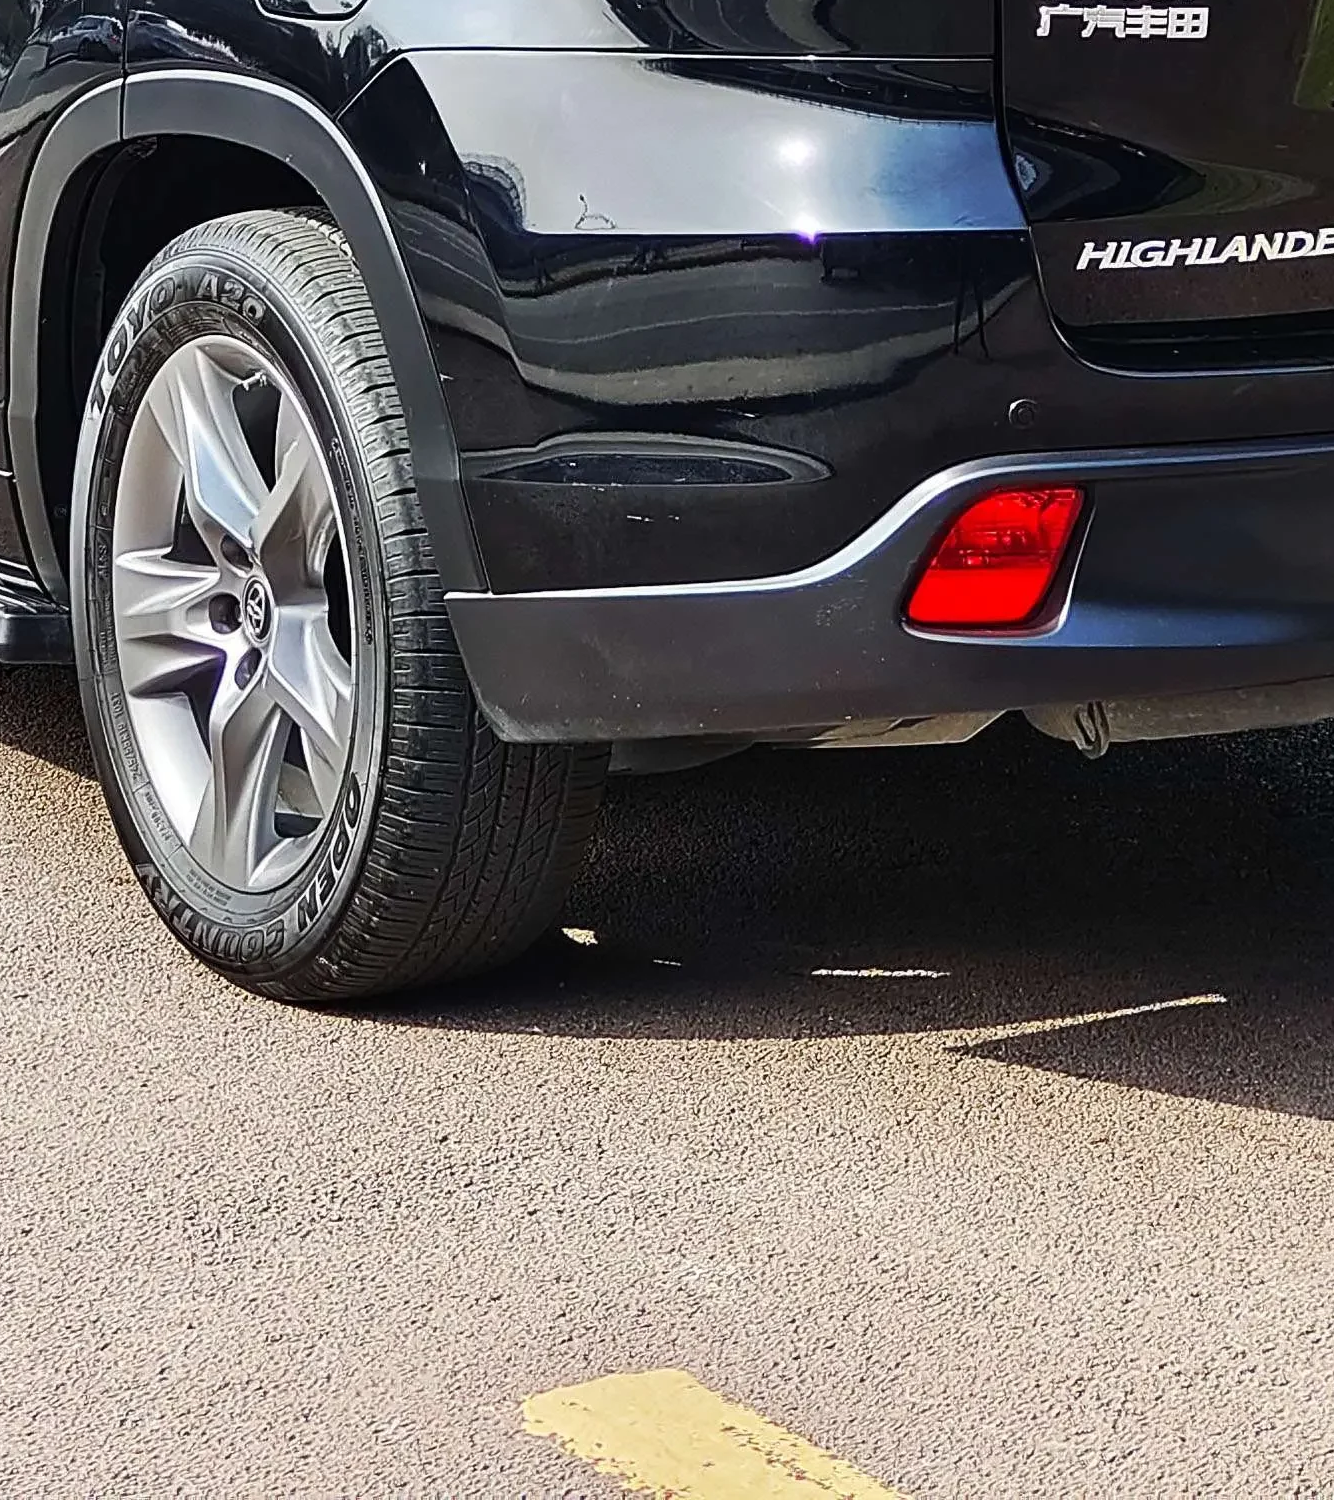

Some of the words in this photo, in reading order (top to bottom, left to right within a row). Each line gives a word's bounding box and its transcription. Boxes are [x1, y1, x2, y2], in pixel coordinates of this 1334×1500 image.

[1036, 5, 1209, 39] 广汽丰田
[297, 770, 363, 933] OPEN
